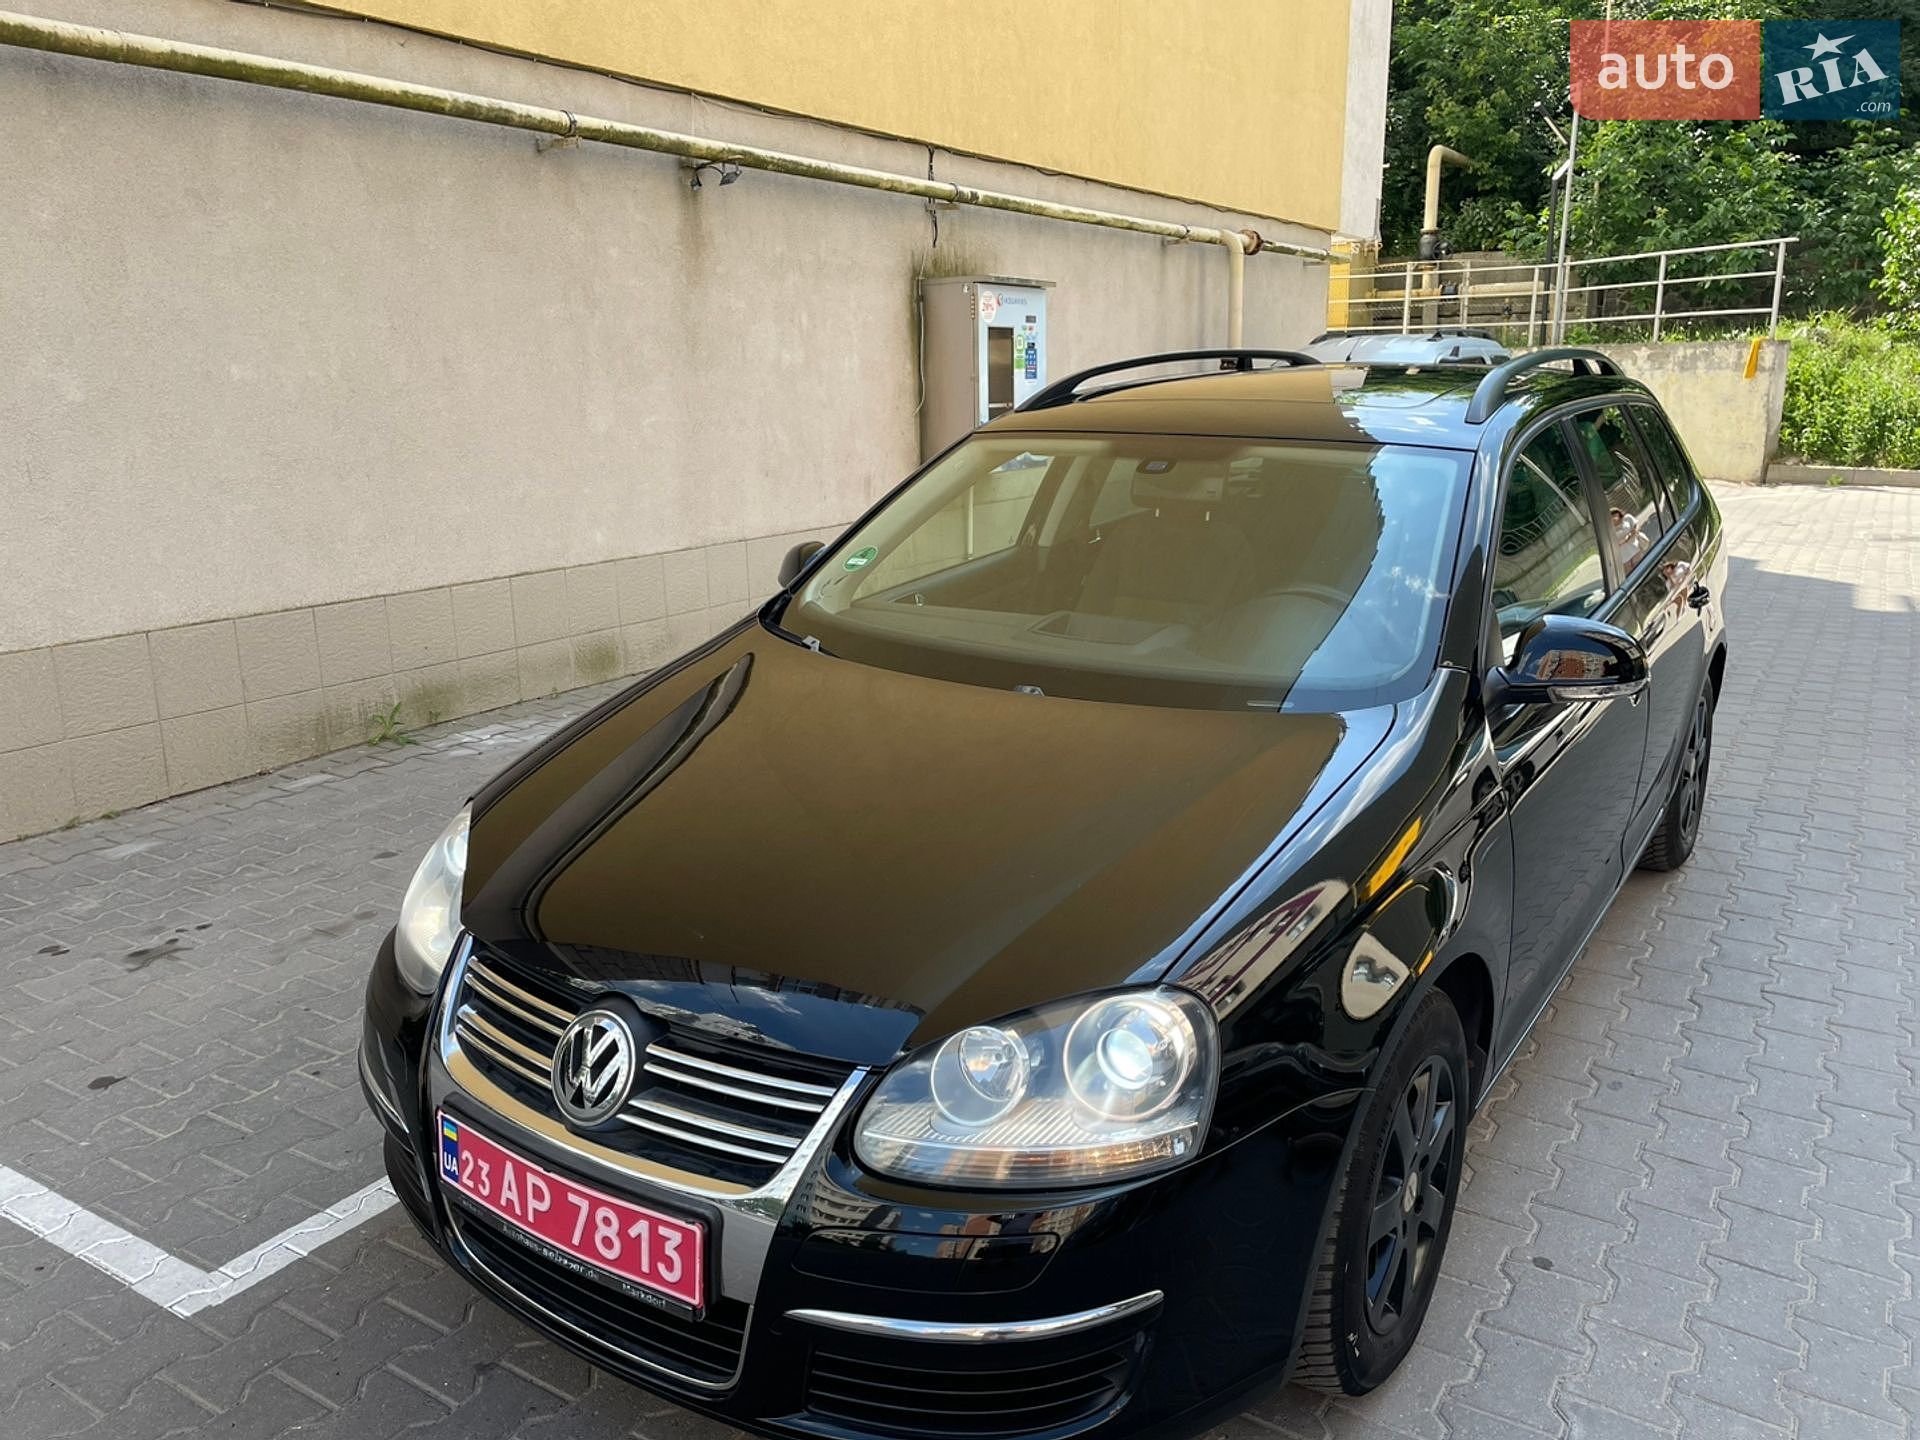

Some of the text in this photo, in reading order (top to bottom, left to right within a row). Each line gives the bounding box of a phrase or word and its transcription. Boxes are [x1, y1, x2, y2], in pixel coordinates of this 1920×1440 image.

[443, 1155, 459, 1176] UA
[461, 1149, 683, 1283] 23 AP 7813
